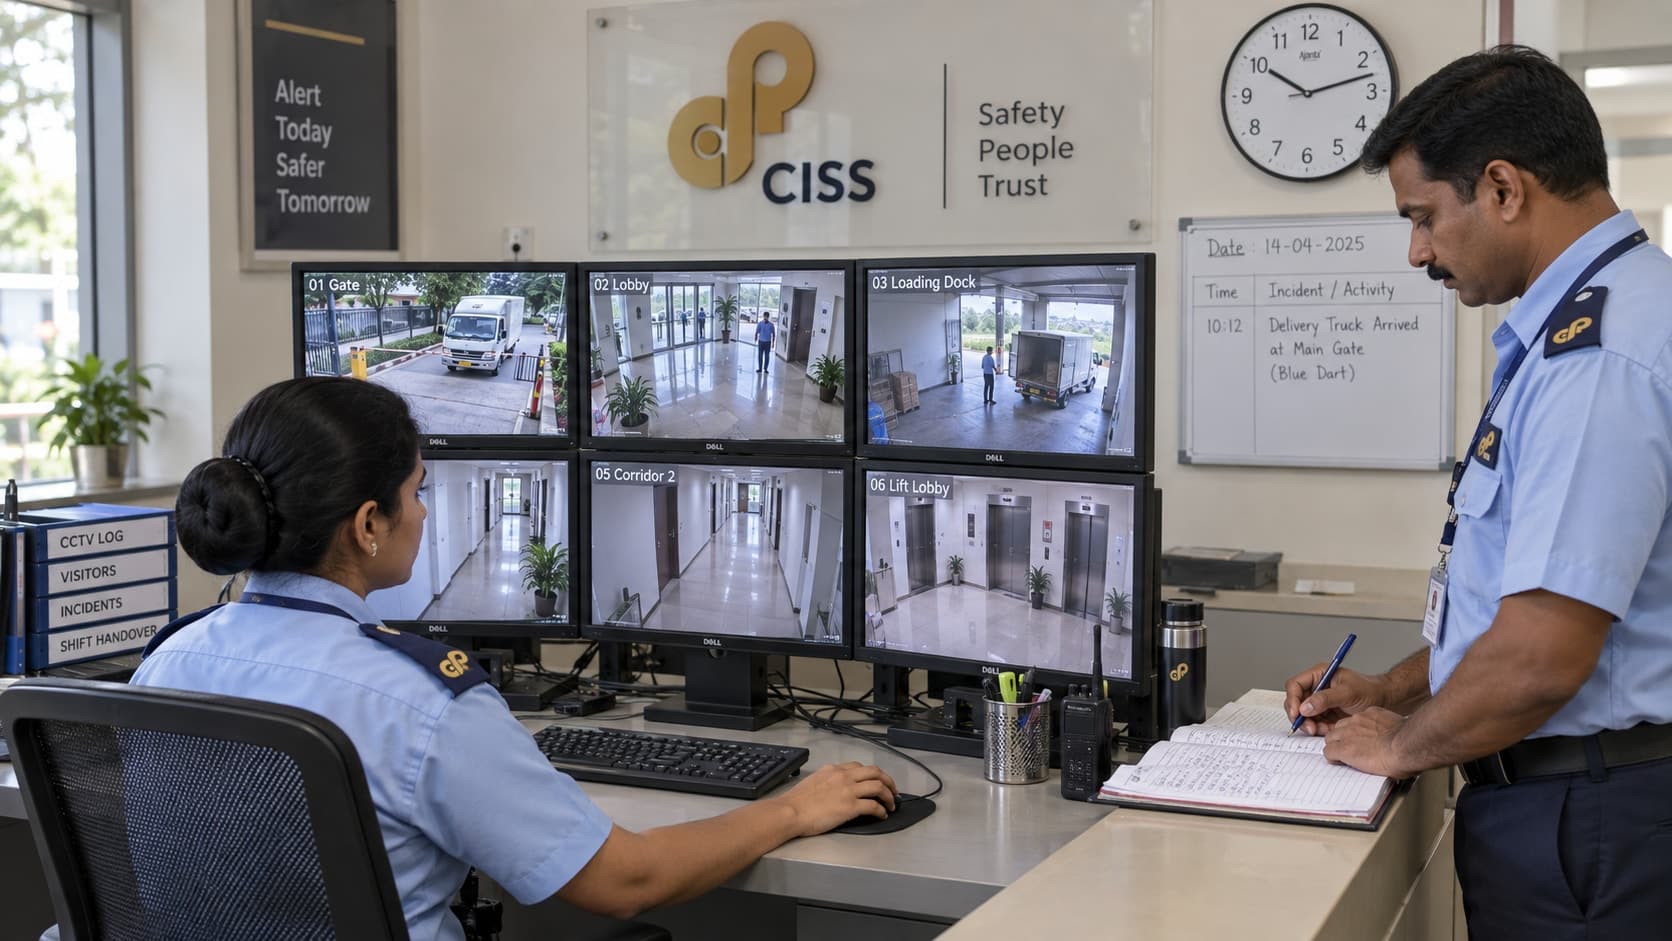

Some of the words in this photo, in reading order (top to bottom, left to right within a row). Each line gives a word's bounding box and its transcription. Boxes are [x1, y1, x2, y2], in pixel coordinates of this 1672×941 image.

[1272, 33, 1287, 49] 11
[1301, 23, 1319, 41] 12
[1337, 30, 1343, 47] 1
[1251, 57, 1268, 73] 10
[1357, 51, 1368, 68] 2
[275, 79, 321, 107] Alert
[1241, 88, 1252, 104] 9
[1366, 83, 1377, 100] 3
[979, 101, 1065, 128] Safety
[1355, 115, 1367, 132] 4
[276, 116, 332, 148] Today
[1249, 119, 1261, 135] 8
[979, 136, 1074, 166] People
[1272, 140, 1282, 156] 7
[1302, 148, 1313, 164] 6
[1333, 139, 1343, 155] 5
[276, 152, 325, 178] Safer
[762, 159, 876, 205] CISS
[978, 173, 1048, 198] Trust
[276, 189, 370, 214] Tomorrow
[1207, 238, 1245, 257] Date
[1265, 236, 1365, 255] 14-04-2025
[308, 279, 324, 291] 01
[329, 278, 360, 292] Gate
[594, 279, 609, 291] 02
[613, 278, 649, 295] Lobby
[872, 276, 888, 290] 03
[891, 275, 940, 292] Loading
[944, 274, 976, 289] Dock
[1206, 283, 1239, 299] Time
[1269, 282, 1323, 299] Incident
[1344, 281, 1395, 301] Activity
[1207, 318, 1243, 334] 10:12
[1269, 317, 1319, 337] Delivery
[1326, 317, 1363, 332] Truck
[1373, 316, 1419, 331] Arrived
[1270, 343, 1283, 356] at
[1294, 343, 1324, 356] Main
[1332, 341, 1365, 356] Gate
[1270, 364, 1307, 383] (Blue
[1317, 364, 1356, 382] Dart)
[595, 468, 611, 481] 05
[614, 468, 664, 483] Corridor
[667, 470, 676, 483] 2
[870, 479, 886, 492] 06
[889, 478, 909, 493] Lift
[912, 479, 950, 498] Lobby
[60, 533, 94, 548] CCTV
[98, 530, 124, 544] LOG
[60, 564, 117, 583] VISITORS
[60, 597, 122, 617] INCIDENTS
[60, 636, 93, 653] SHIFT
[96, 625, 157, 646] HANDOVER
